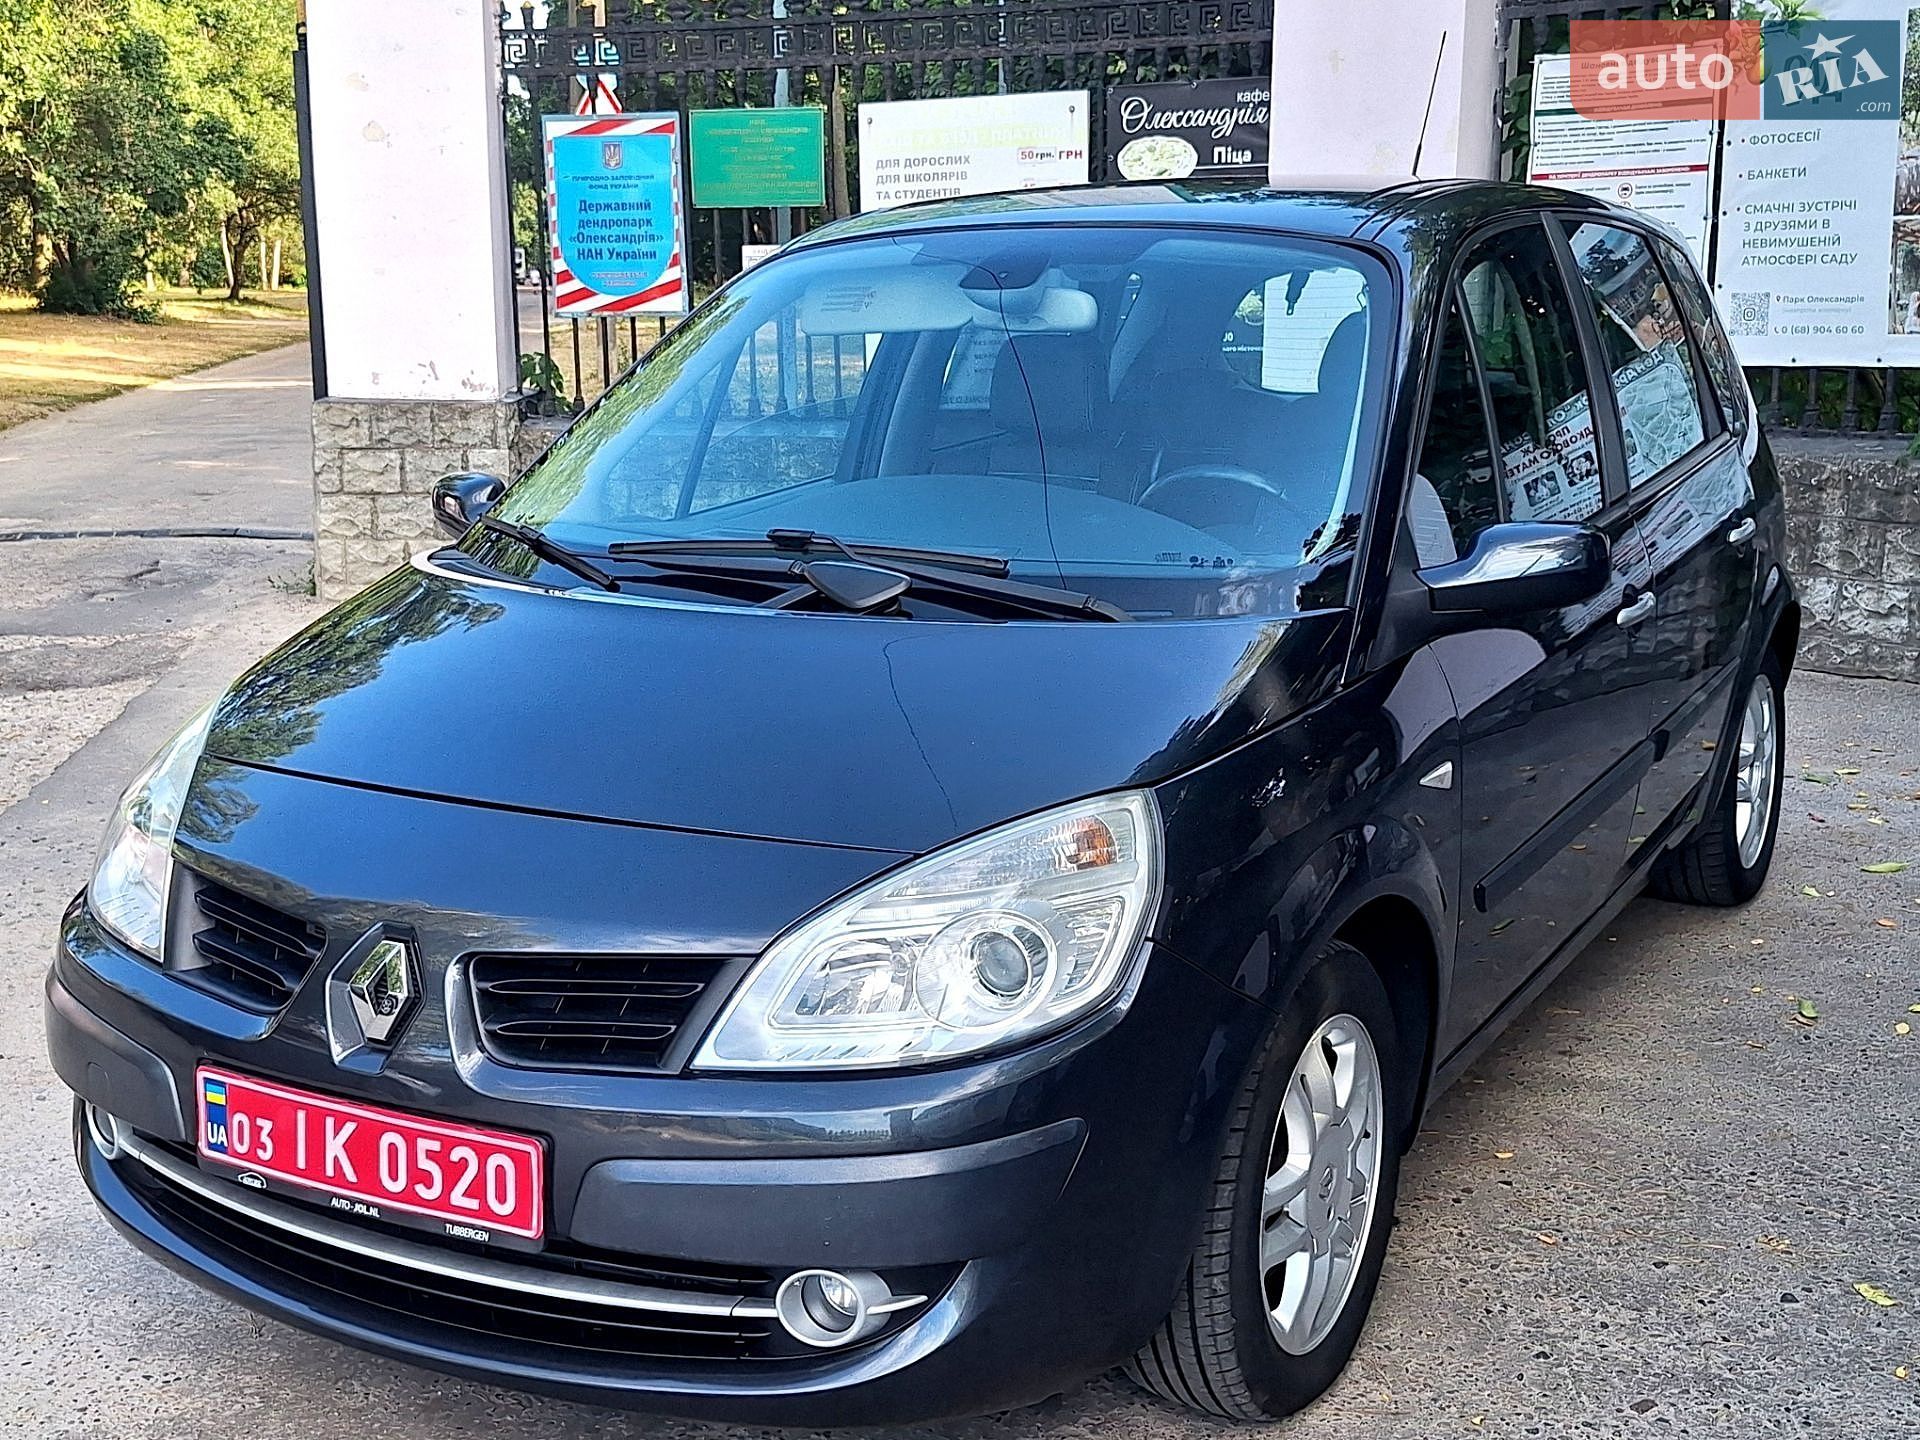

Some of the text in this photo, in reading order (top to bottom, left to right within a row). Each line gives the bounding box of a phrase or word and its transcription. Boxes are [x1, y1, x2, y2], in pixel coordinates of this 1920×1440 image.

[1236, 88, 1270, 103] кафе
[1120, 96, 1270, 139] Олександрія
[1749, 128, 1821, 146] ФОТОСЕСІЇ
[876, 154, 971, 170] ДЛЯ ДОРОСЛИХ
[1058, 149, 1083, 160] ГРН
[1213, 146, 1252, 165] Піца
[876, 170, 968, 185] ДЛЯ ШКОЛЯРІВ
[1747, 166, 1807, 181] БАНКЕТИ
[876, 190, 892, 201] ТА
[579, 199, 651, 214] Державний
[1744, 199, 1857, 215] СМАЧНІ ЗУСТРІЧІ
[578, 217, 653, 231] дендропарк
[1743, 218, 1831, 233] З ДРУЗЯМИ В
[570, 231, 664, 244] «Олександрія»
[1742, 233, 1841, 249] НЕВИМУШЕНІЙ
[577, 247, 657, 261] НАН України
[1741, 252, 1858, 267] АТМОСФЕРІ САДУ
[1783, 295, 1805, 304] Парк
[1813, 325, 1833, 335] 904
[1835, 325, 1848, 335] 60
[1850, 324, 1865, 335] 60
[206, 1109, 517, 1217] UA 03 IK 0520
[444, 1223, 489, 1242] TUBBERGEN
